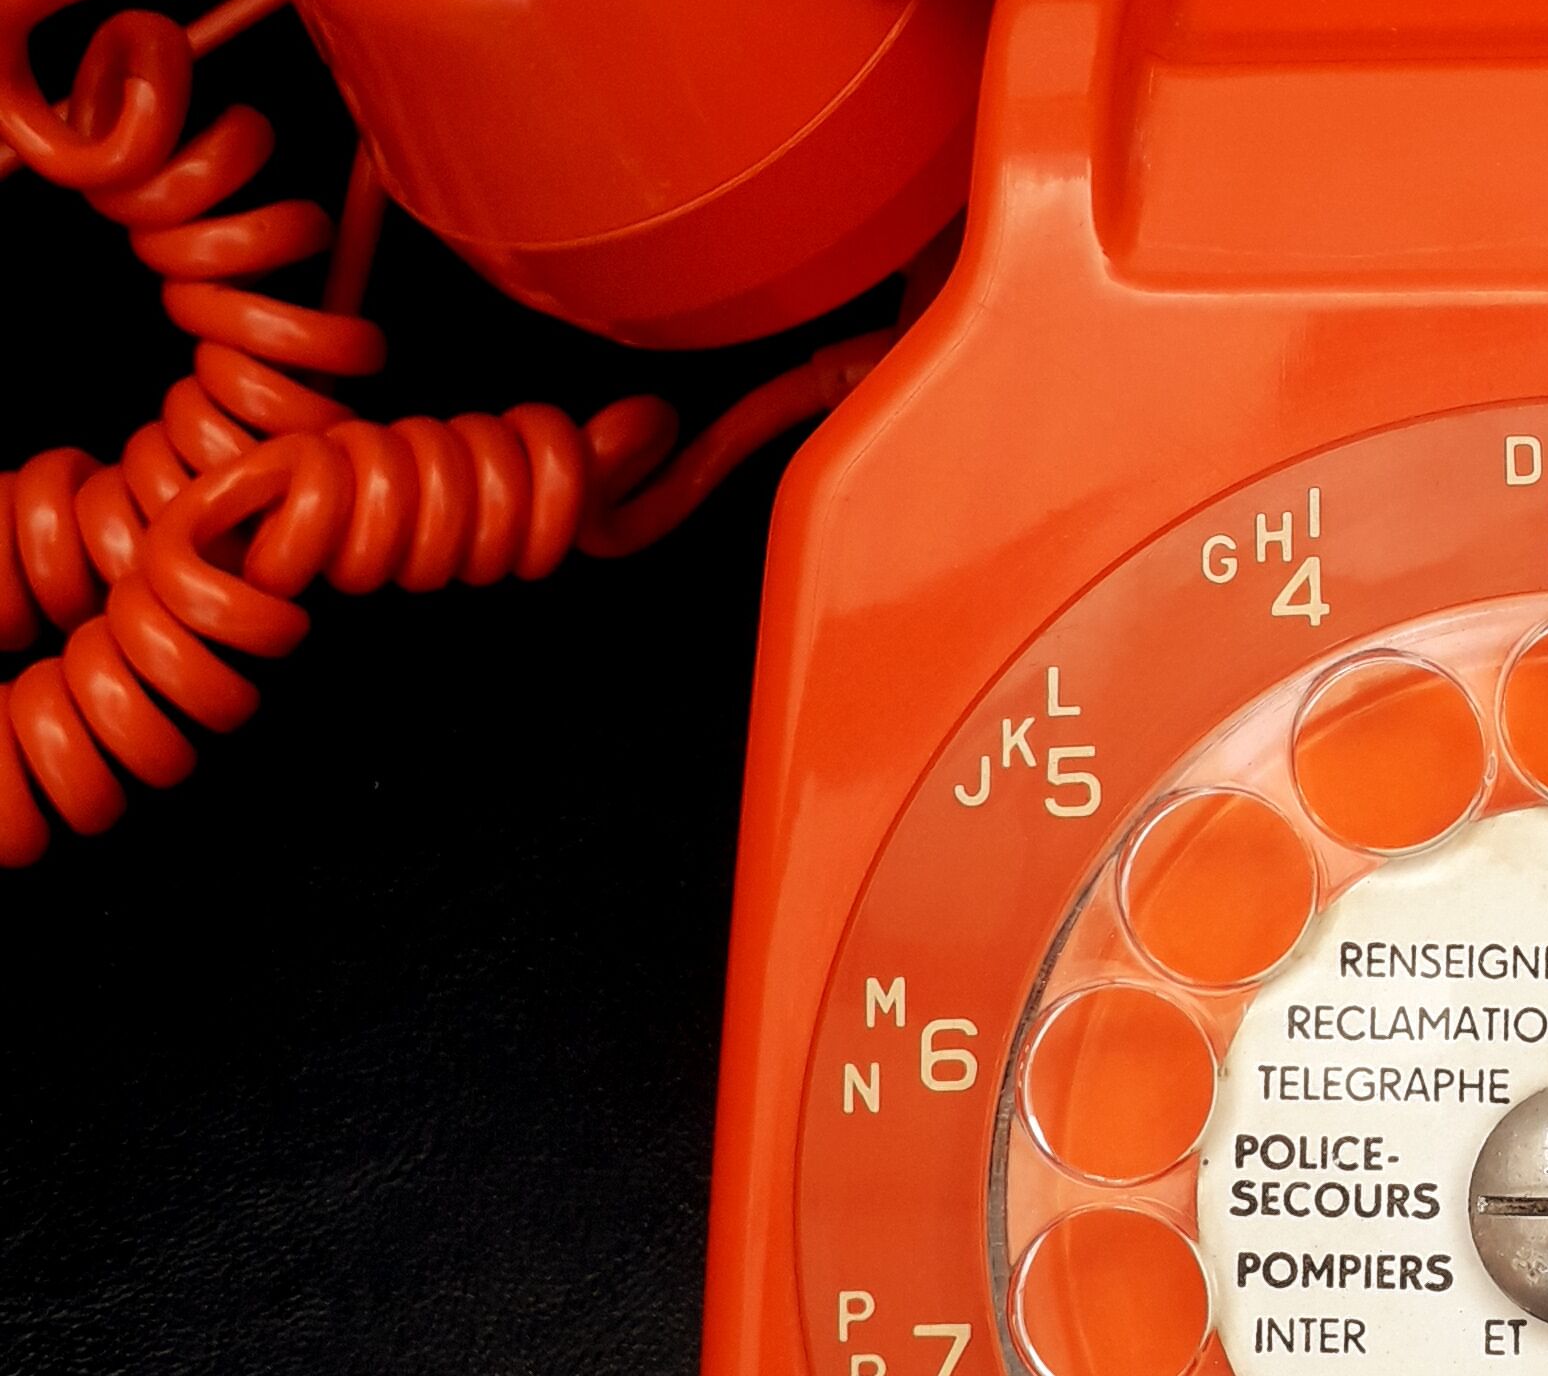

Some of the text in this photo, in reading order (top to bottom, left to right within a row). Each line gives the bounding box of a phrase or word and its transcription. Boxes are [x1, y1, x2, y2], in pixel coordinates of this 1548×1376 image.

[1270, 555, 1331, 627] 4
[1043, 744, 1102, 818] 5
[919, 1017, 979, 1092] 6
[1257, 1064, 1512, 1106] TELEGRAPHE
[1234, 1133, 1401, 1173] POLICE-
[1228, 1180, 1442, 1221] SECOURS
[1236, 1250, 1455, 1293] POMPIERS
[1254, 1316, 1367, 1355] INTER
[1483, 1318, 1530, 1357] ET
